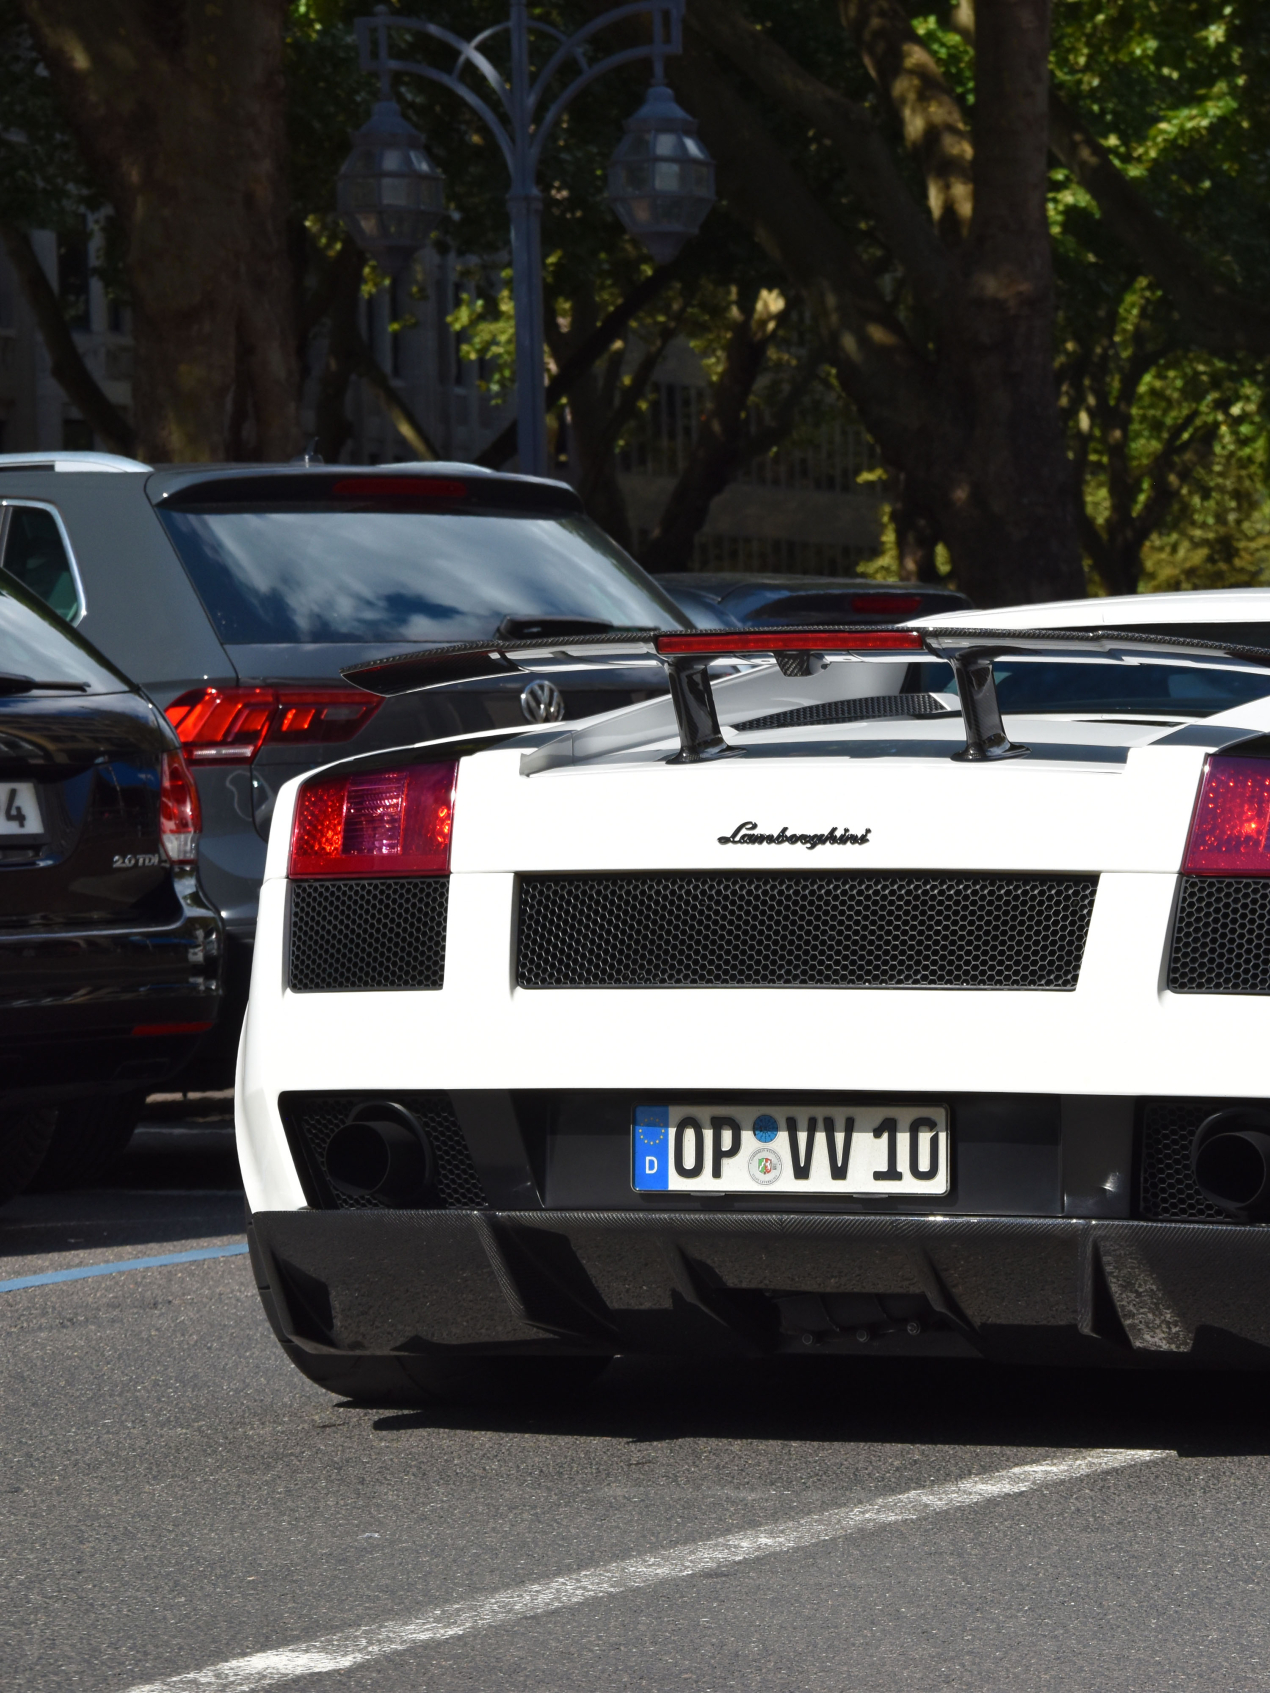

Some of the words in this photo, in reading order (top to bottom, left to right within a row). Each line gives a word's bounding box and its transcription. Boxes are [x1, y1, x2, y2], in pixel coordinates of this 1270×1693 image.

[5, 788, 26, 828] 4
[717, 821, 872, 850] Lamborghini
[645, 1156, 658, 1174] D
[673, 1116, 742, 1179] OP
[786, 1116, 855, 1180] VV
[872, 1117, 939, 1181] 10
